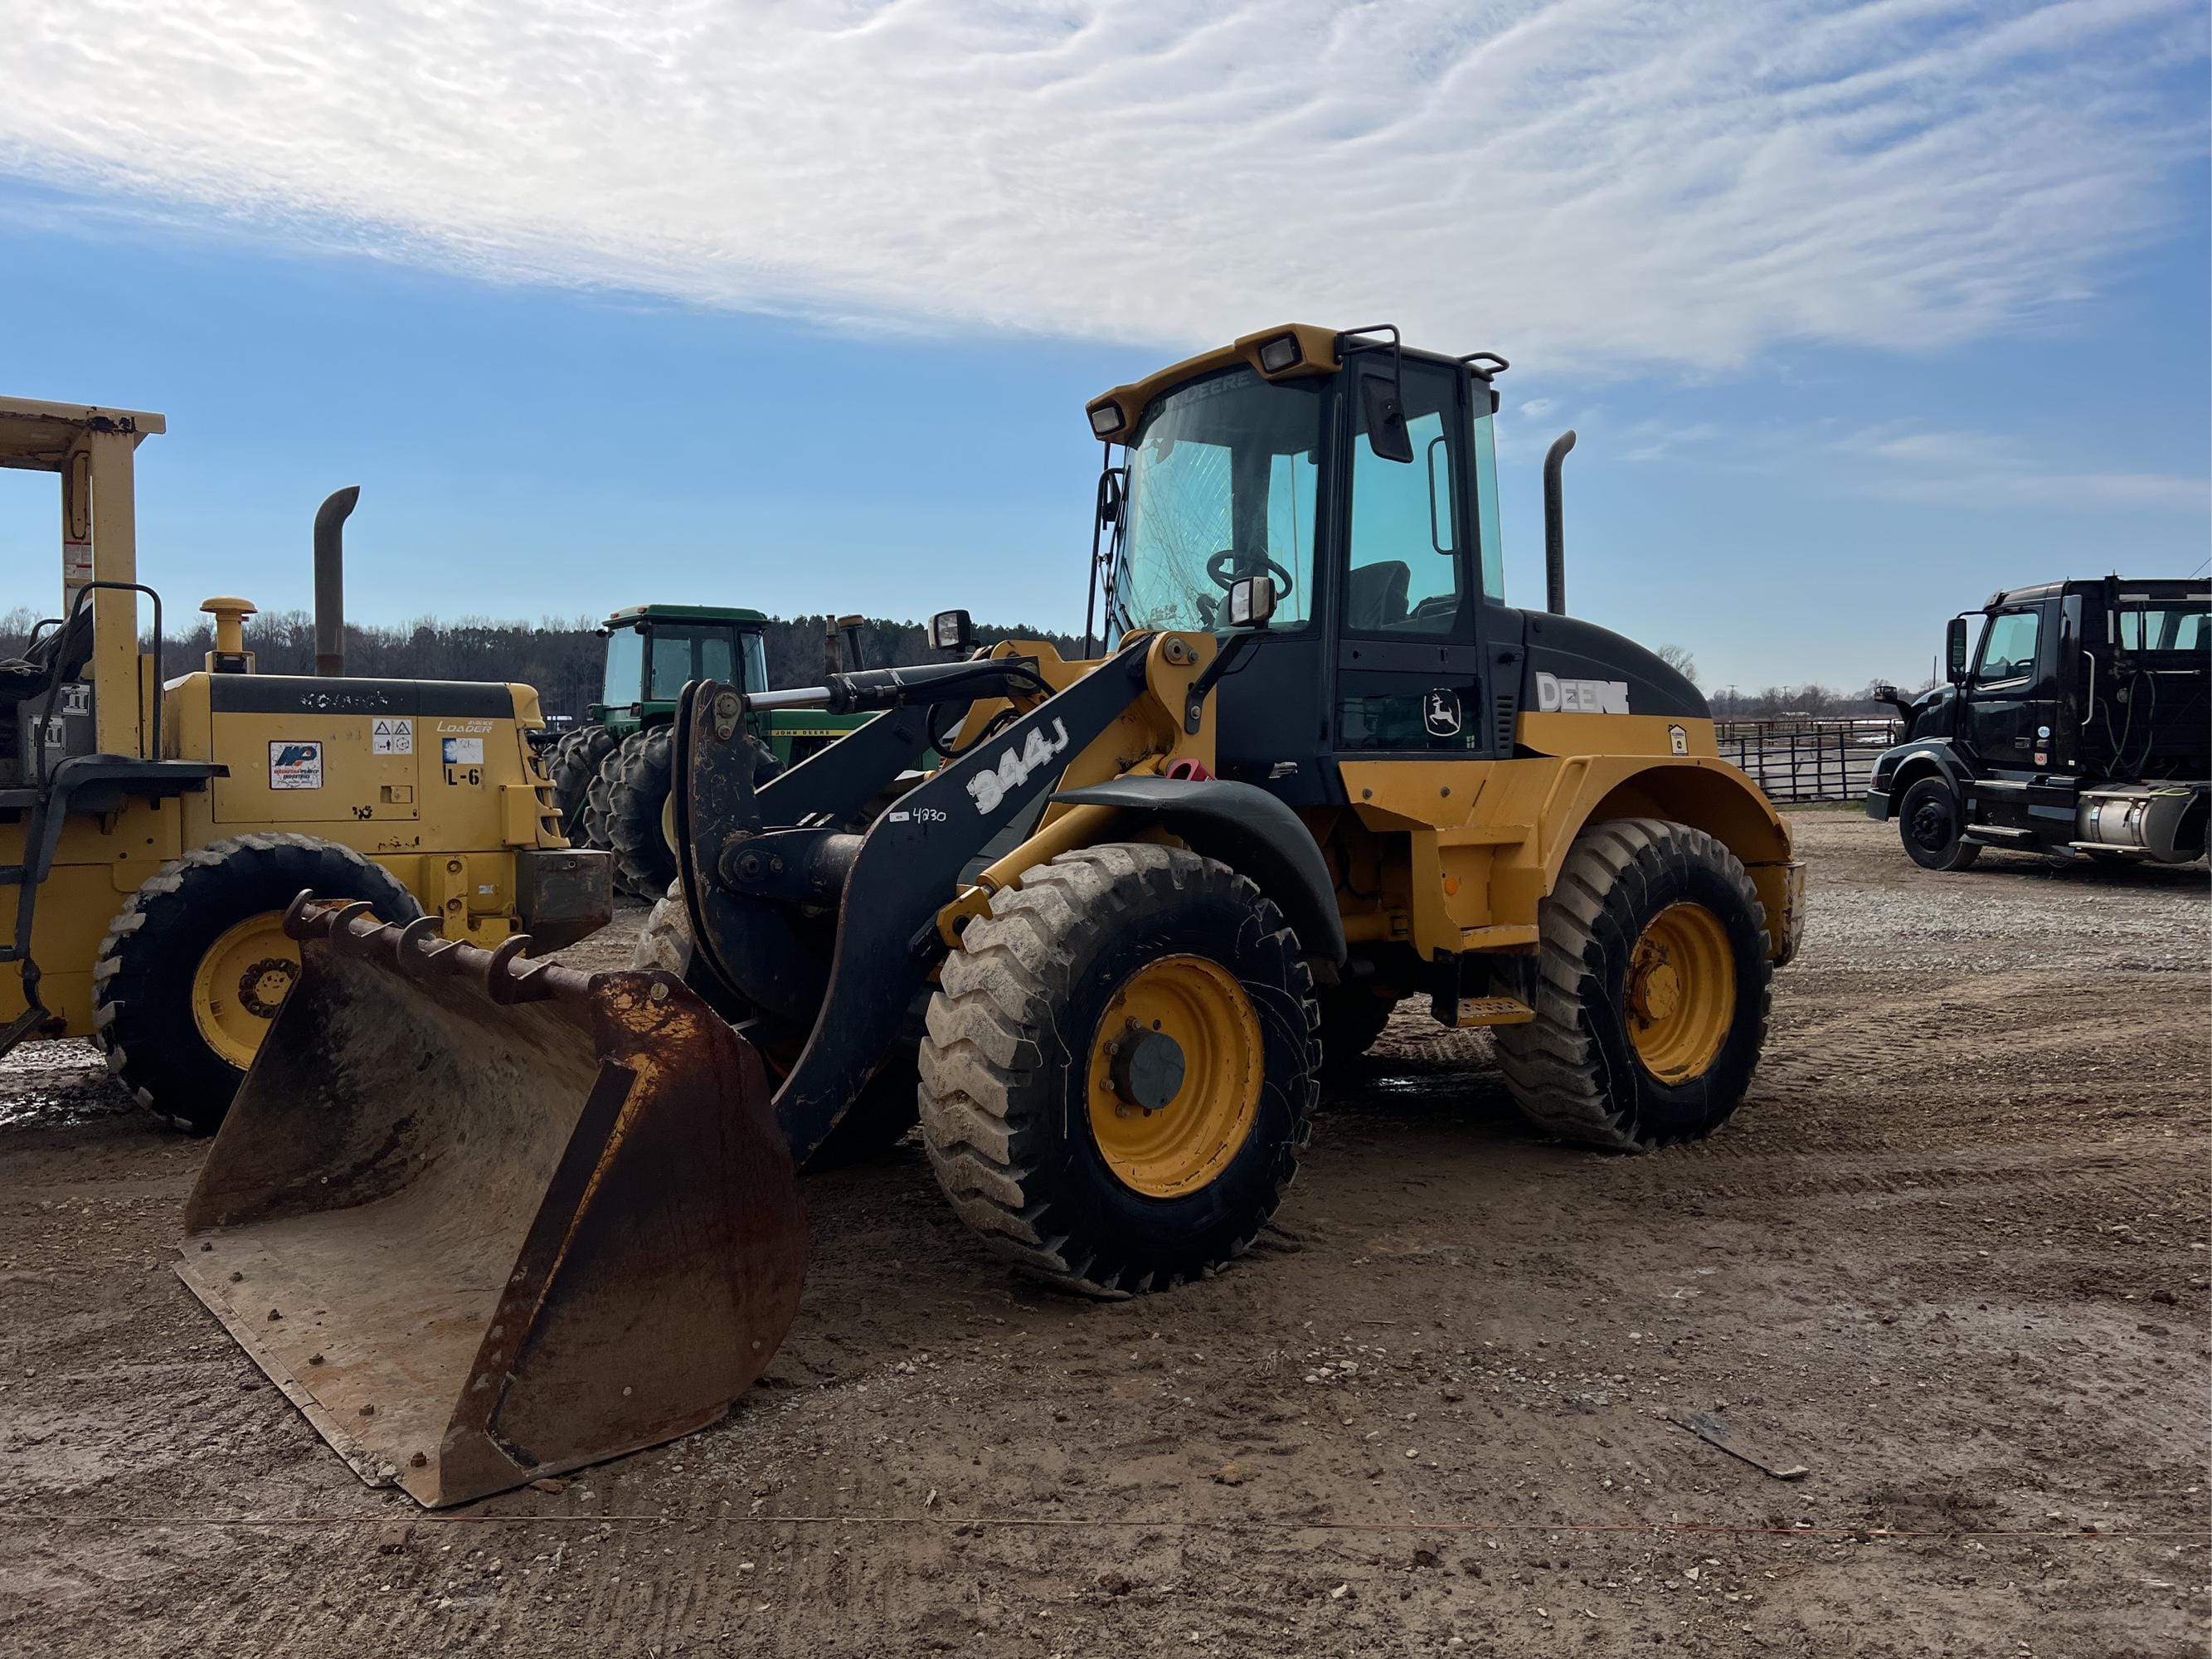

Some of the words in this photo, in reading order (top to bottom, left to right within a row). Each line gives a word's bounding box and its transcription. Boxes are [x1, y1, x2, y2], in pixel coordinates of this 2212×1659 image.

[1185, 374, 1250, 403] DEERE
[436, 721, 492, 733] LOADER
[448, 768, 479, 786] L-6
[913, 807, 946, 824] 4230
